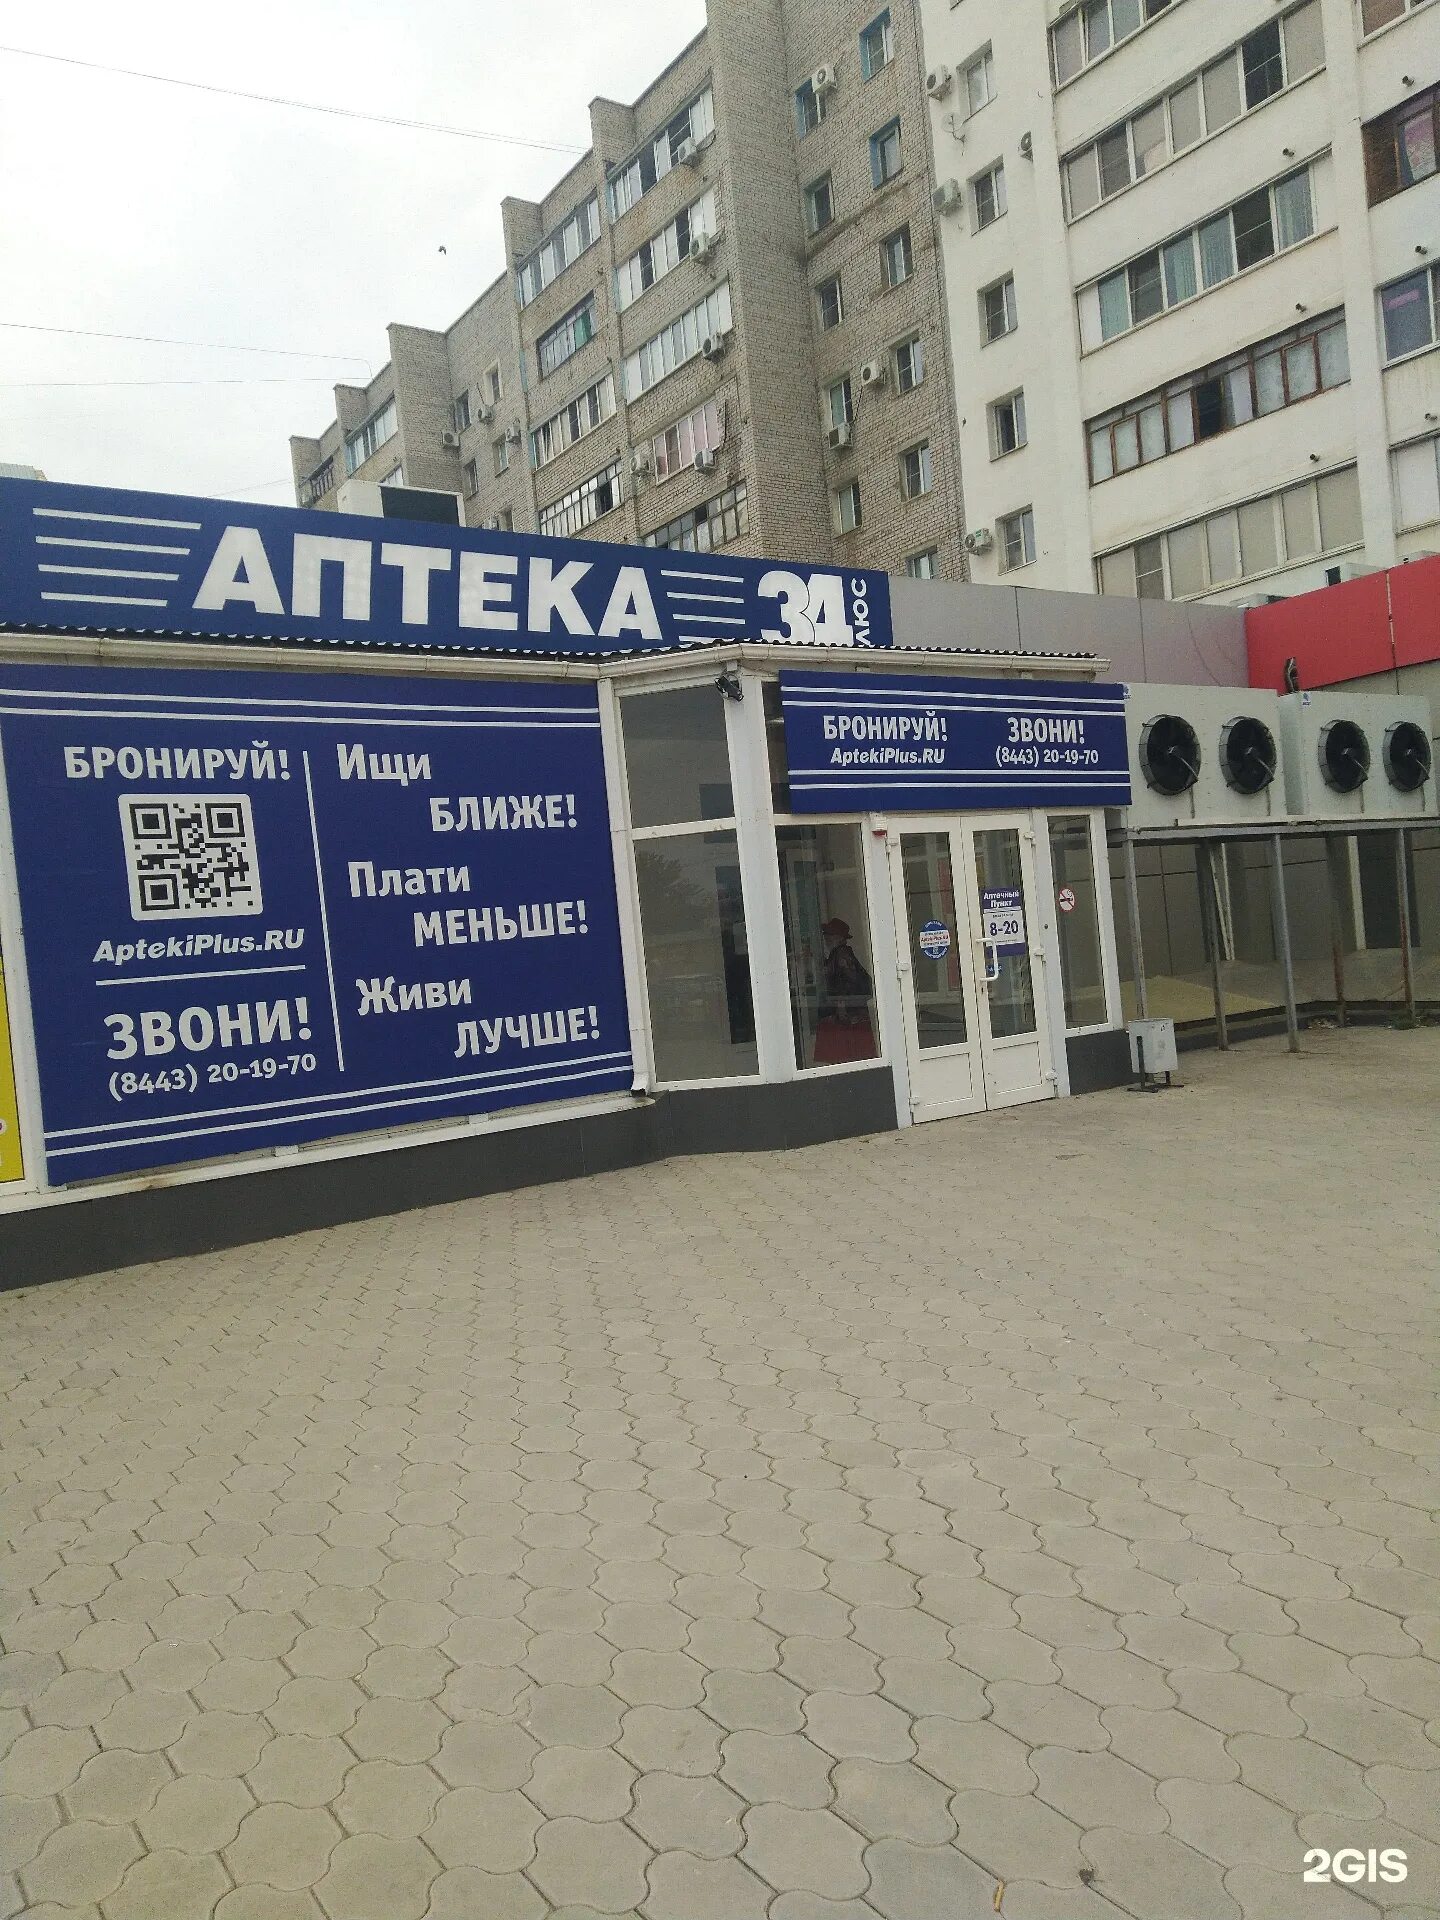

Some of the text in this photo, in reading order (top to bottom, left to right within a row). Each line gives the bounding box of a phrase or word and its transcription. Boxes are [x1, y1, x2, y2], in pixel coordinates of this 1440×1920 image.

[192, 526, 854, 647] АПТЕКА 34
[850, 577, 872, 646] ЛЮС
[823, 710, 948, 741] БРОНИРУЙ!
[1007, 716, 1085, 744] ЗВОНИ!
[63, 740, 291, 781] БРОНИРУЙ!
[336, 743, 432, 786] Ищи
[830, 747, 945, 767] AptekiPlus.RU
[995, 745, 1099, 768] (8443) 20-19-70
[429, 793, 578, 832] БЛИЖЕ!
[347, 860, 471, 898] Плати
[983, 890, 1020, 900] Аптечный
[413, 899, 589, 948] МЕНЬШЕ!
[990, 900, 1013, 909] Пункт
[92, 928, 305, 966] AptekiPlus.RU
[990, 920, 1019, 936] 8-20
[355, 975, 472, 1016] Живи
[103, 996, 312, 1061] ЗВОНИ!
[453, 1005, 600, 1059] ЛУЧШЕ!
[108, 1053, 317, 1102] (8443) 20-19-70
